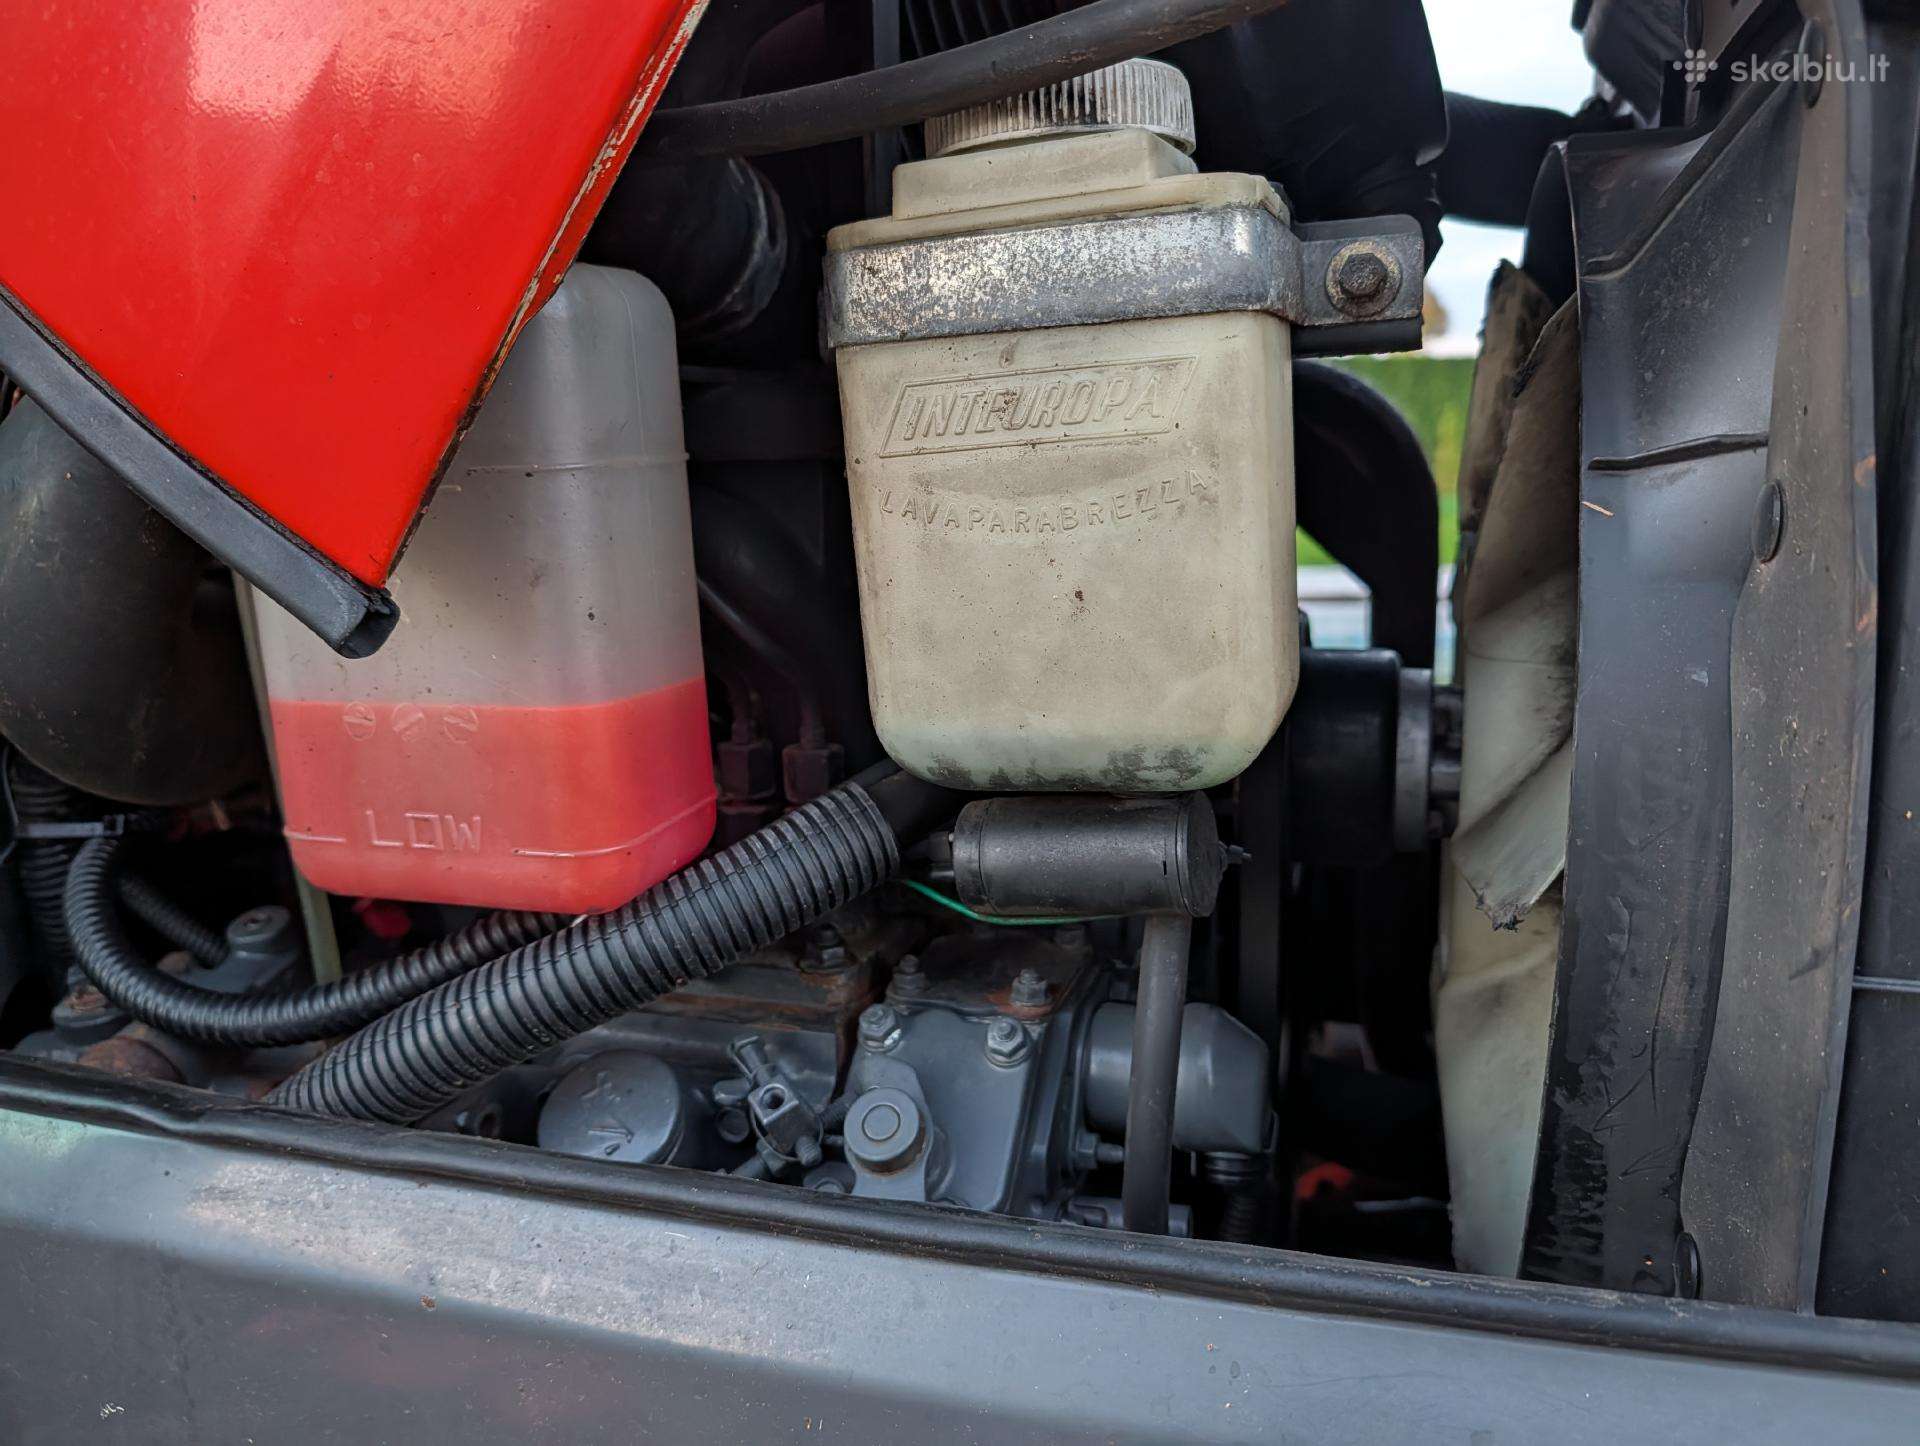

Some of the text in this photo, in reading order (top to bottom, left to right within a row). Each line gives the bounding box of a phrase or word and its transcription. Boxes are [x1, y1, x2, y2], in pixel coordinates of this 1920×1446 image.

[903, 374, 1162, 441] INTEUROPA
[880, 470, 1208, 534] LAVAPARABREZZA
[365, 810, 481, 853] LOW
